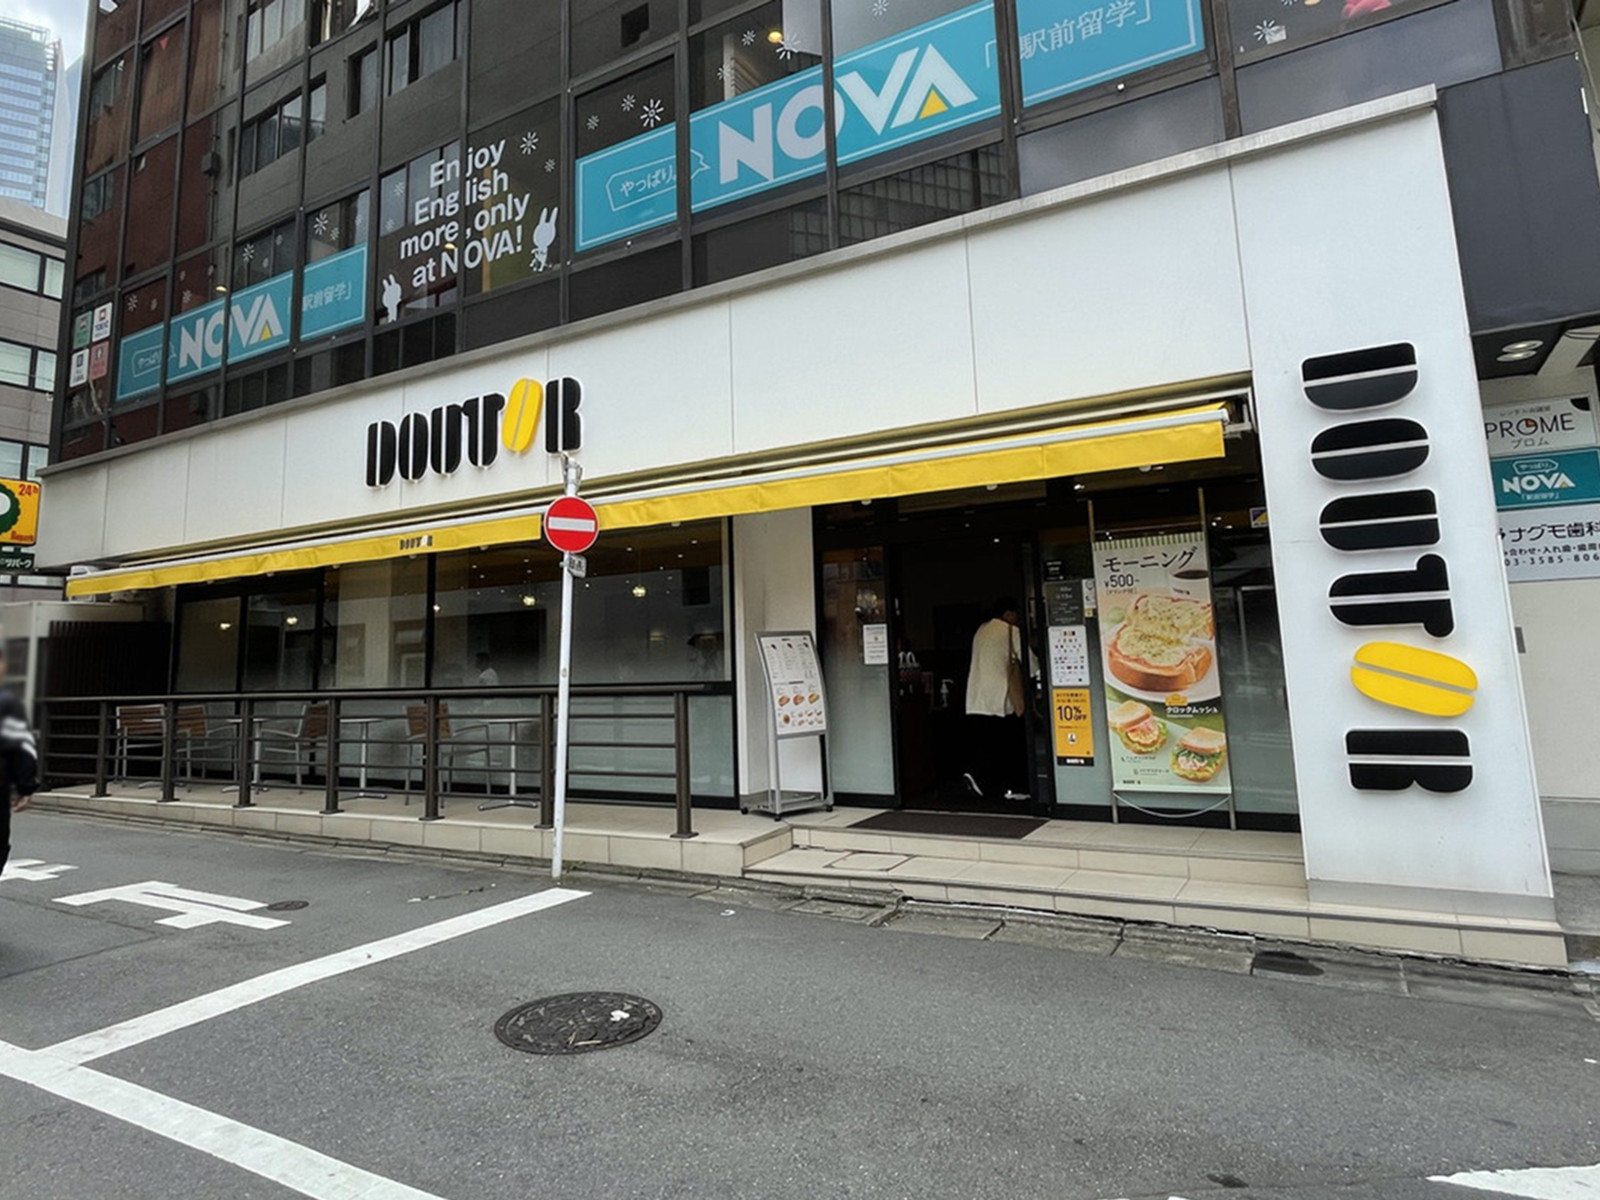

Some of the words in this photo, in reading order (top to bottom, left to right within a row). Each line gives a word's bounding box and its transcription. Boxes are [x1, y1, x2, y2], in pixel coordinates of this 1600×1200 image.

[718, 42, 979, 185] NOVA
[411, 260, 437, 288] at
[178, 293, 284, 370] NOVA
[366, 376, 582, 488] DOUTOR
[1484, 412, 1575, 440] PROME
[1502, 472, 1577, 495] NOVA
[1102, 546, 1198, 573] モーニング
[1301, 342, 1478, 793] DOUTOR
